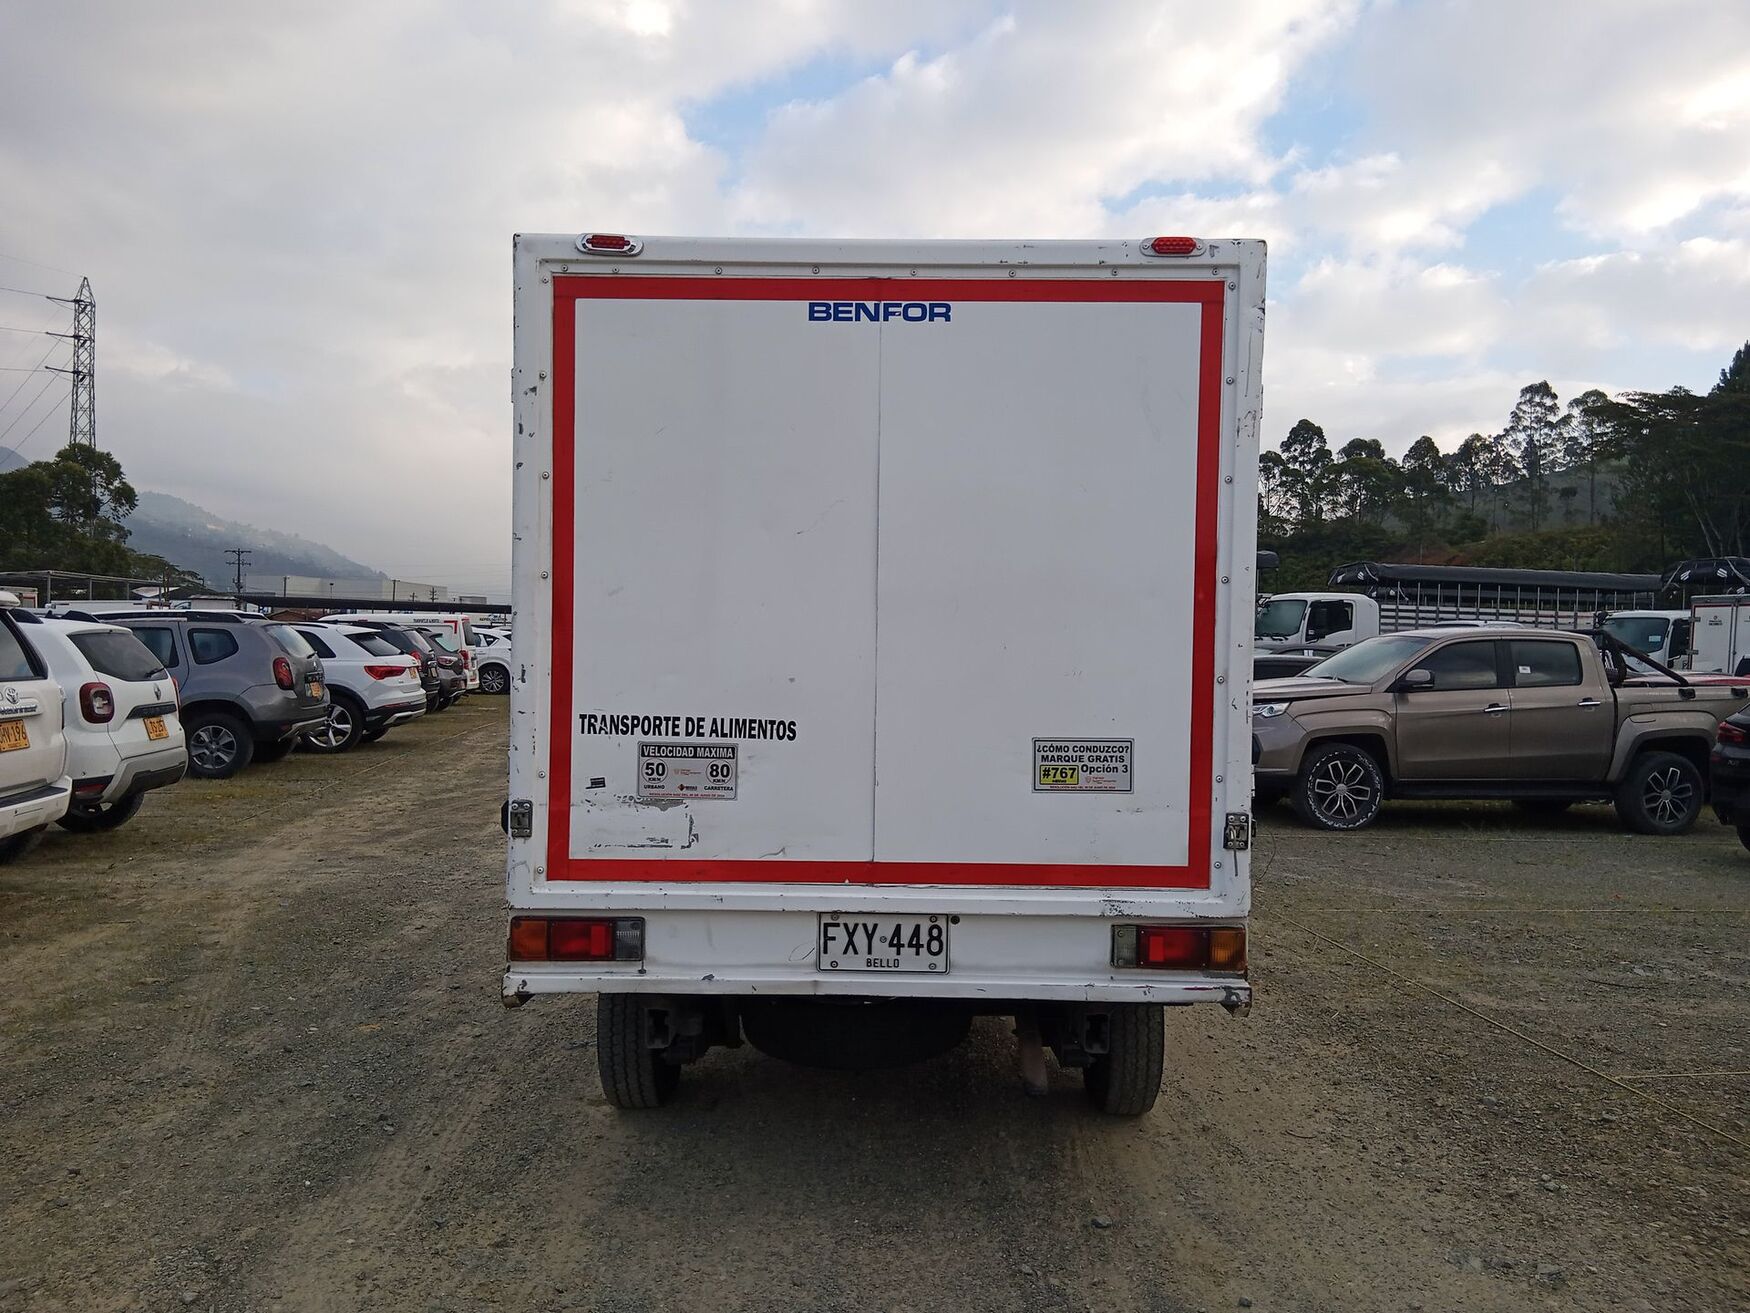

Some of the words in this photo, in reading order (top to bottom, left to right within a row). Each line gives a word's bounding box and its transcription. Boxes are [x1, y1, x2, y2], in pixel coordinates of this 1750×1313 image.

[808, 302, 952, 322] BENFOR
[579, 714, 681, 737] TRANSPORTE
[685, 716, 706, 738] DE
[709, 717, 797, 741] ALIMENTOS
[643, 746, 694, 757] VELOCIDAD
[696, 747, 733, 758] MAXIMA
[1037, 743, 1070, 753] ¿CÓMO
[1072, 745, 1129, 754] CONDUZCO?
[1041, 754, 1085, 763] MARQUE
[1087, 755, 1125, 763] GRATIS
[645, 762, 666, 777] 50
[710, 763, 730, 778] 80
[1042, 766, 1077, 779] #767
[1080, 763, 1119, 775] Opción
[1121, 764, 1129, 773] 3
[866, 958, 900, 968] BELLO
